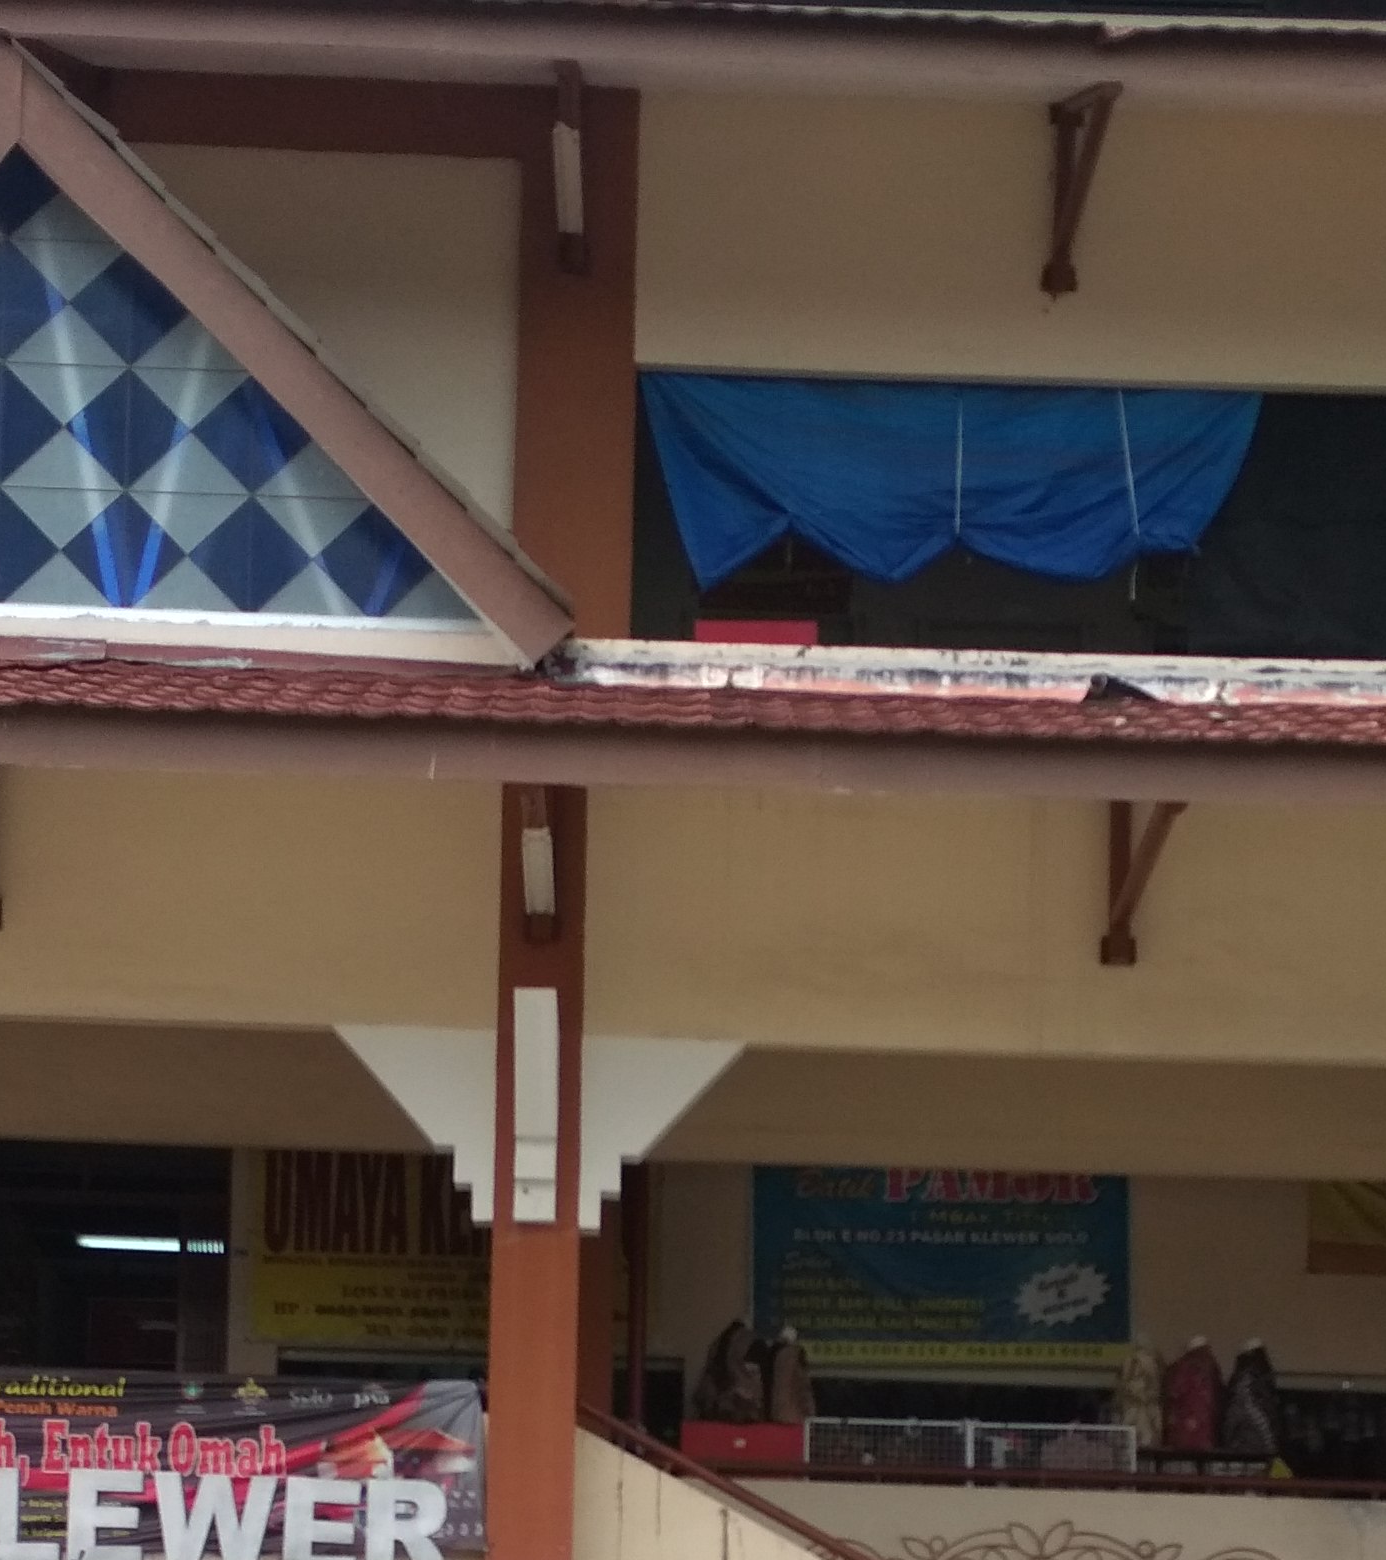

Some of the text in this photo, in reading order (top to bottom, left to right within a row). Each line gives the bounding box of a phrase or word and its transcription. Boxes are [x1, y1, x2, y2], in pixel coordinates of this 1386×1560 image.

[910, 1229, 966, 1244] PASAR
[969, 1230, 1041, 1245] KLEWER
[56, 1401, 119, 1418] Warna
[41, 1418, 163, 1476] Entuk
[168, 1421, 288, 1477] Omah
